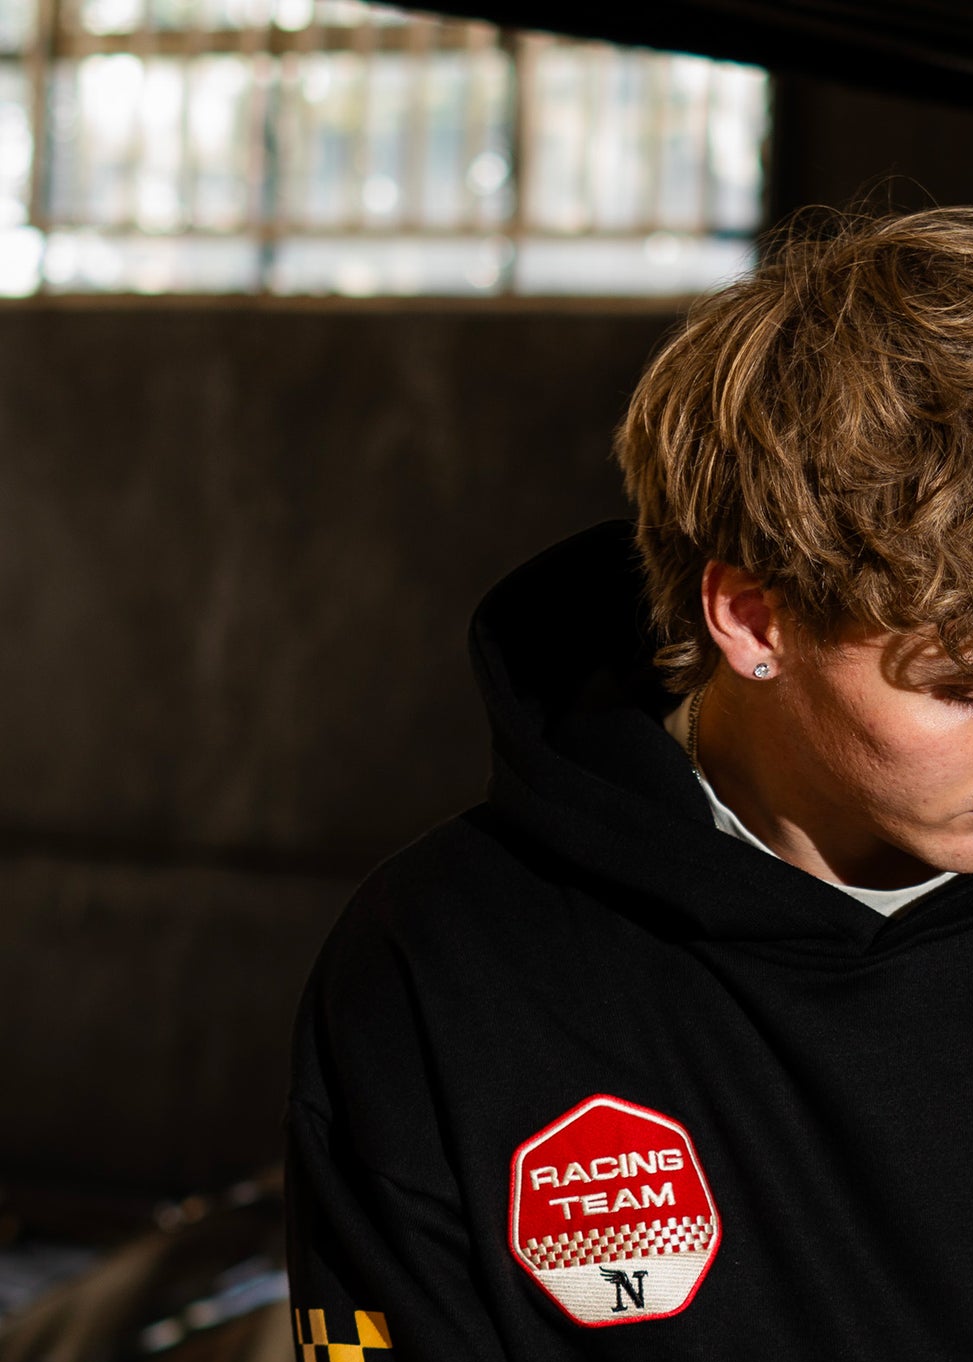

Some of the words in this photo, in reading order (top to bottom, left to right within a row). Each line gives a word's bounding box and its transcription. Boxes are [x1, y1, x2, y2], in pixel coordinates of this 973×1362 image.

[529, 1148, 684, 1191] RACING
[549, 1182, 676, 1220] TEAM
[599, 1266, 649, 1312] N
